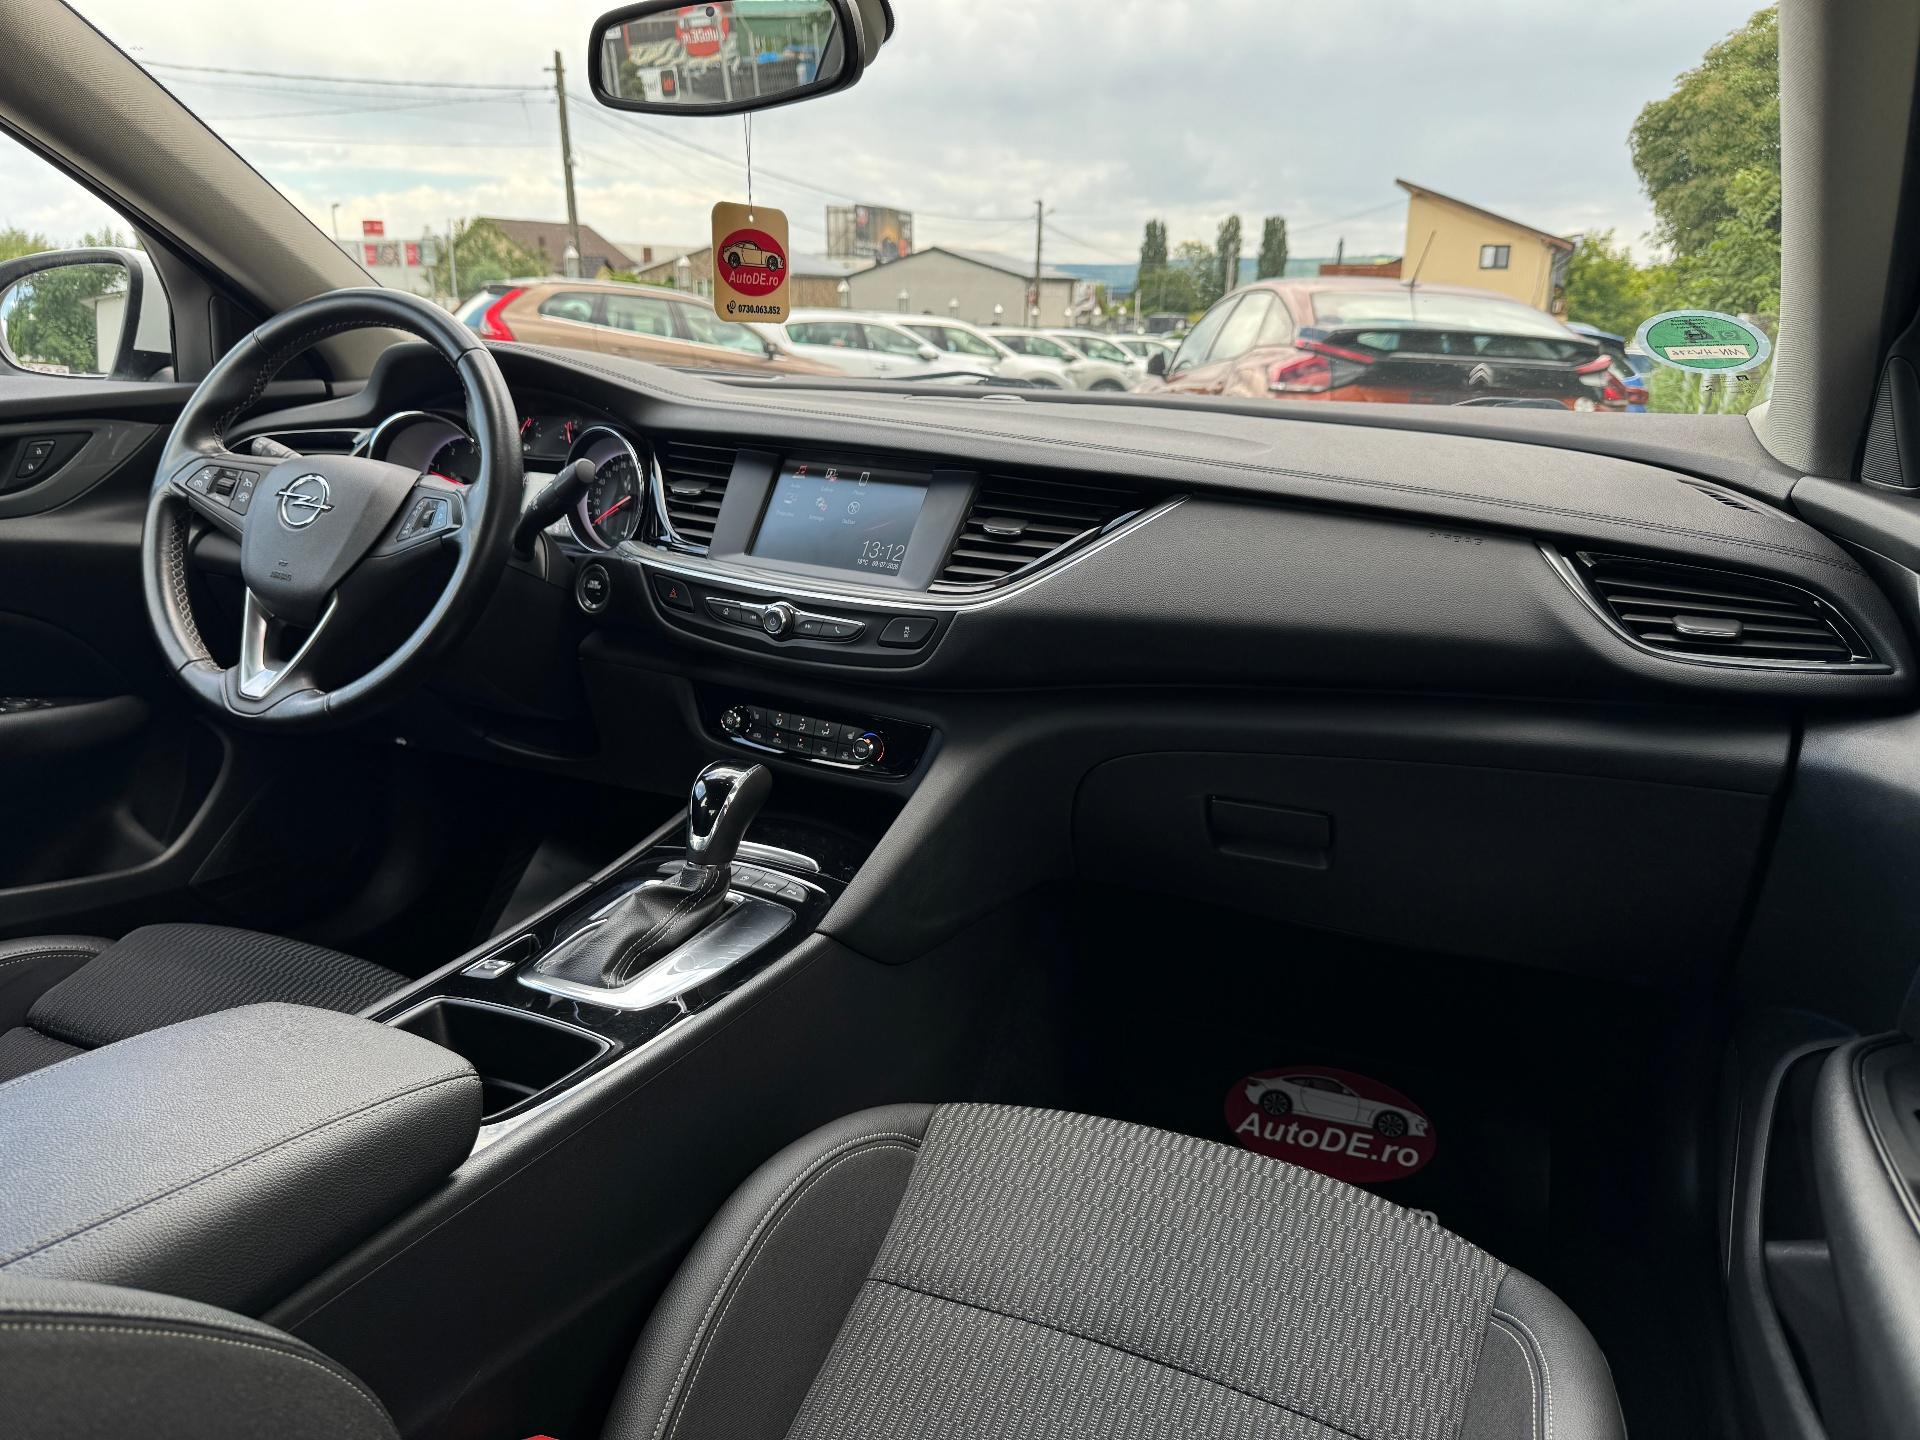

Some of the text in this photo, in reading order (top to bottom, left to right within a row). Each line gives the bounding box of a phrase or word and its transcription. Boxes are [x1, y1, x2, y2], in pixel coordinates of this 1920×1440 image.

[729, 270, 779, 287] AutoDE.ro
[738, 304, 781, 315] 0730.063.852
[862, 540, 905, 562] 13:12
[1235, 1112, 1420, 1168] AutoDE.ro
